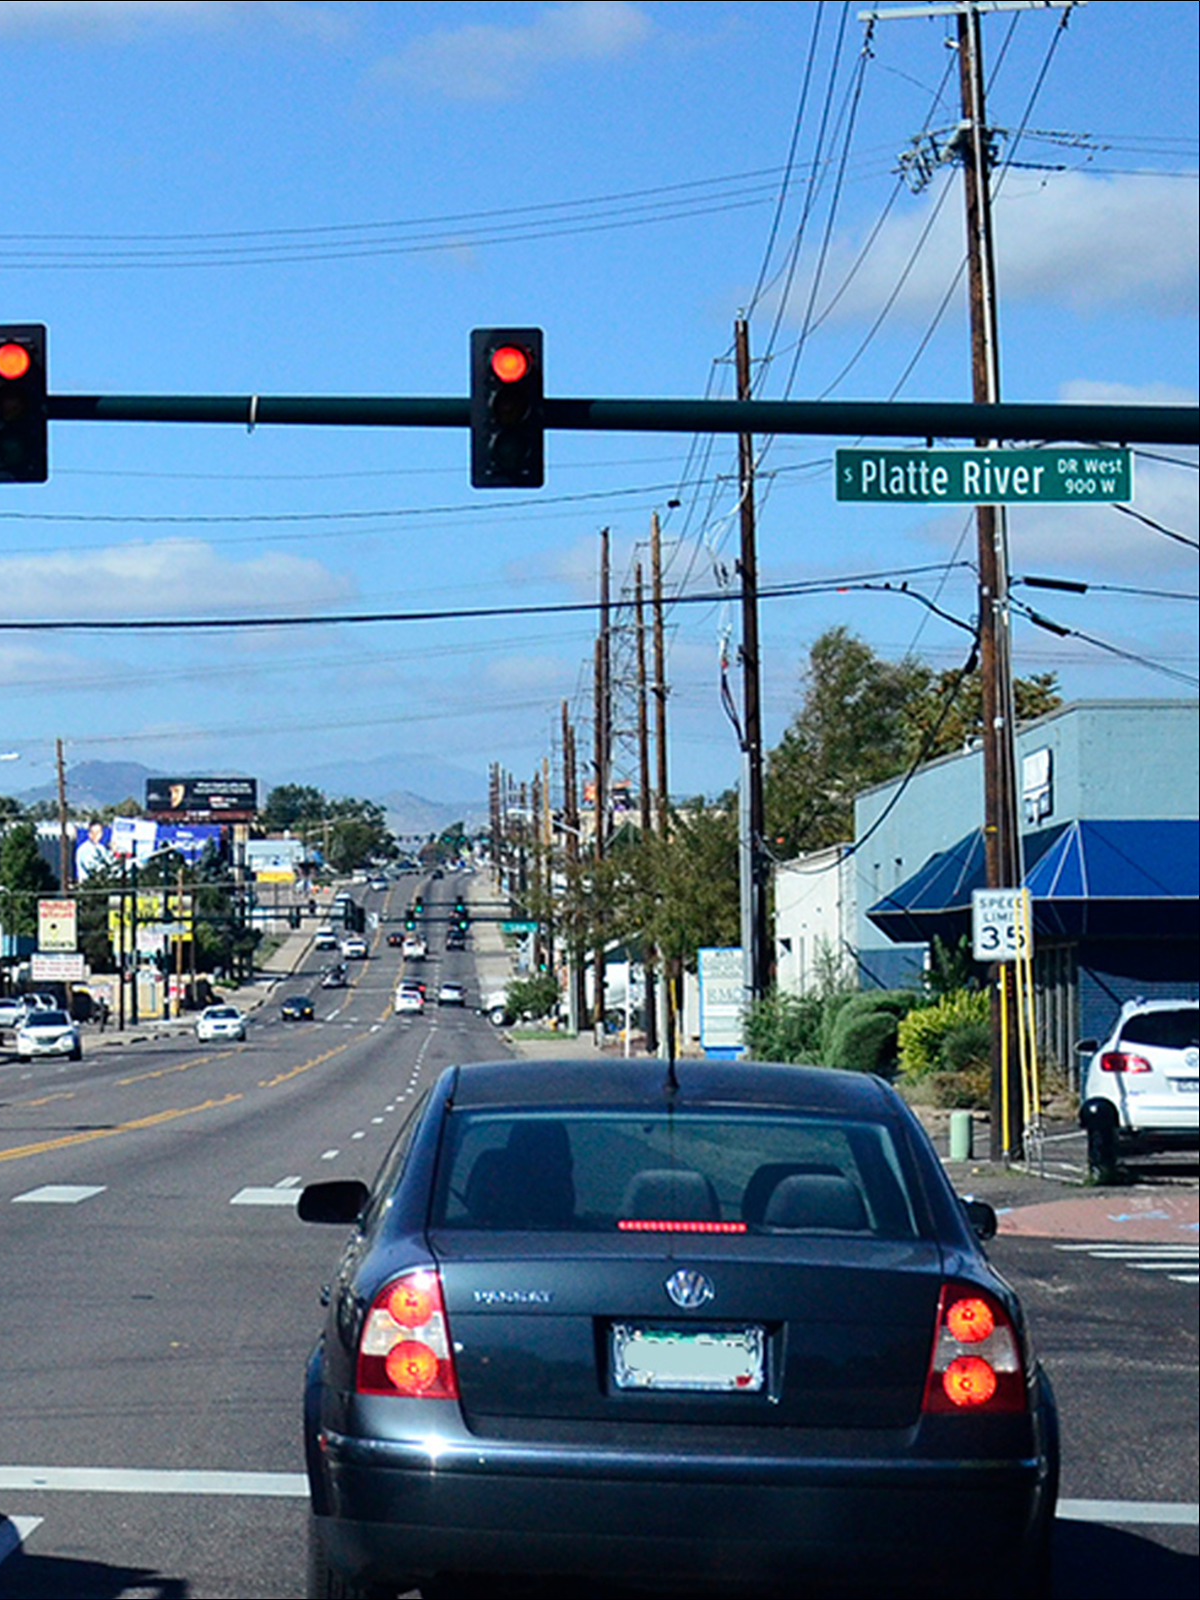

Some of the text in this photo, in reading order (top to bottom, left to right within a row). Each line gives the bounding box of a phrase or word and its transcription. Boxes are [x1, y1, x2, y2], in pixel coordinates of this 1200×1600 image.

[844, 457, 1045, 495] S Platte River
[1057, 458, 1123, 474] DR West
[1064, 478, 1116, 494] 900 W
[981, 925, 1026, 951] 35
